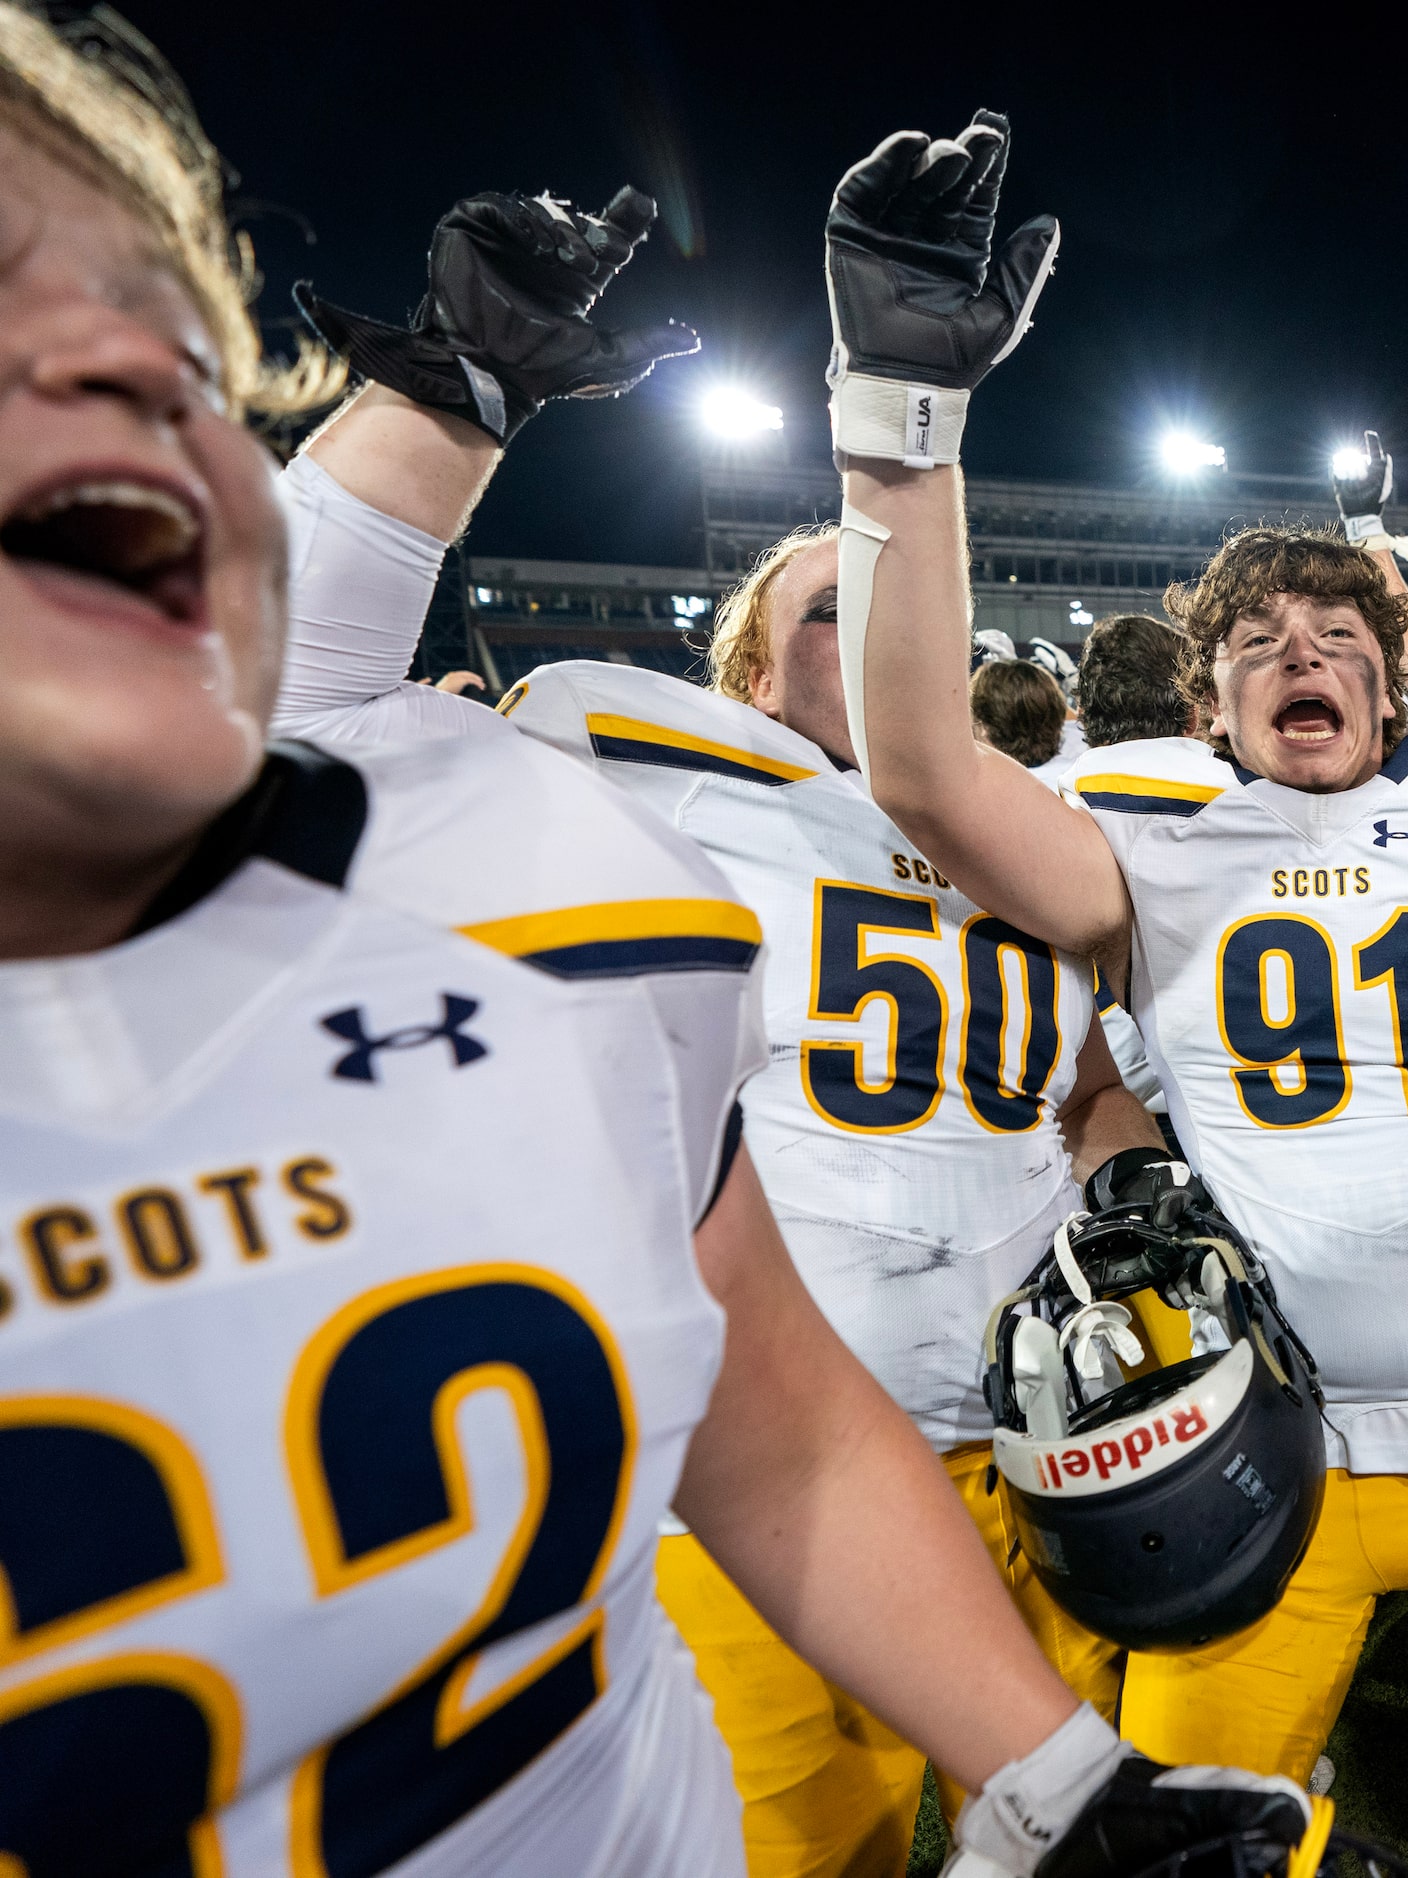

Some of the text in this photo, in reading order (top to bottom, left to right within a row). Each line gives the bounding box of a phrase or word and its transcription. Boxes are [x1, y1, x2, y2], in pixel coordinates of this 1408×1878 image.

[917, 396, 931, 427] UA
[1272, 866, 1371, 898] SCOTS
[800, 877, 1063, 1134] 50
[0, 1156, 354, 1322] COTS
[1036, 1397, 1209, 1491] Riddell
